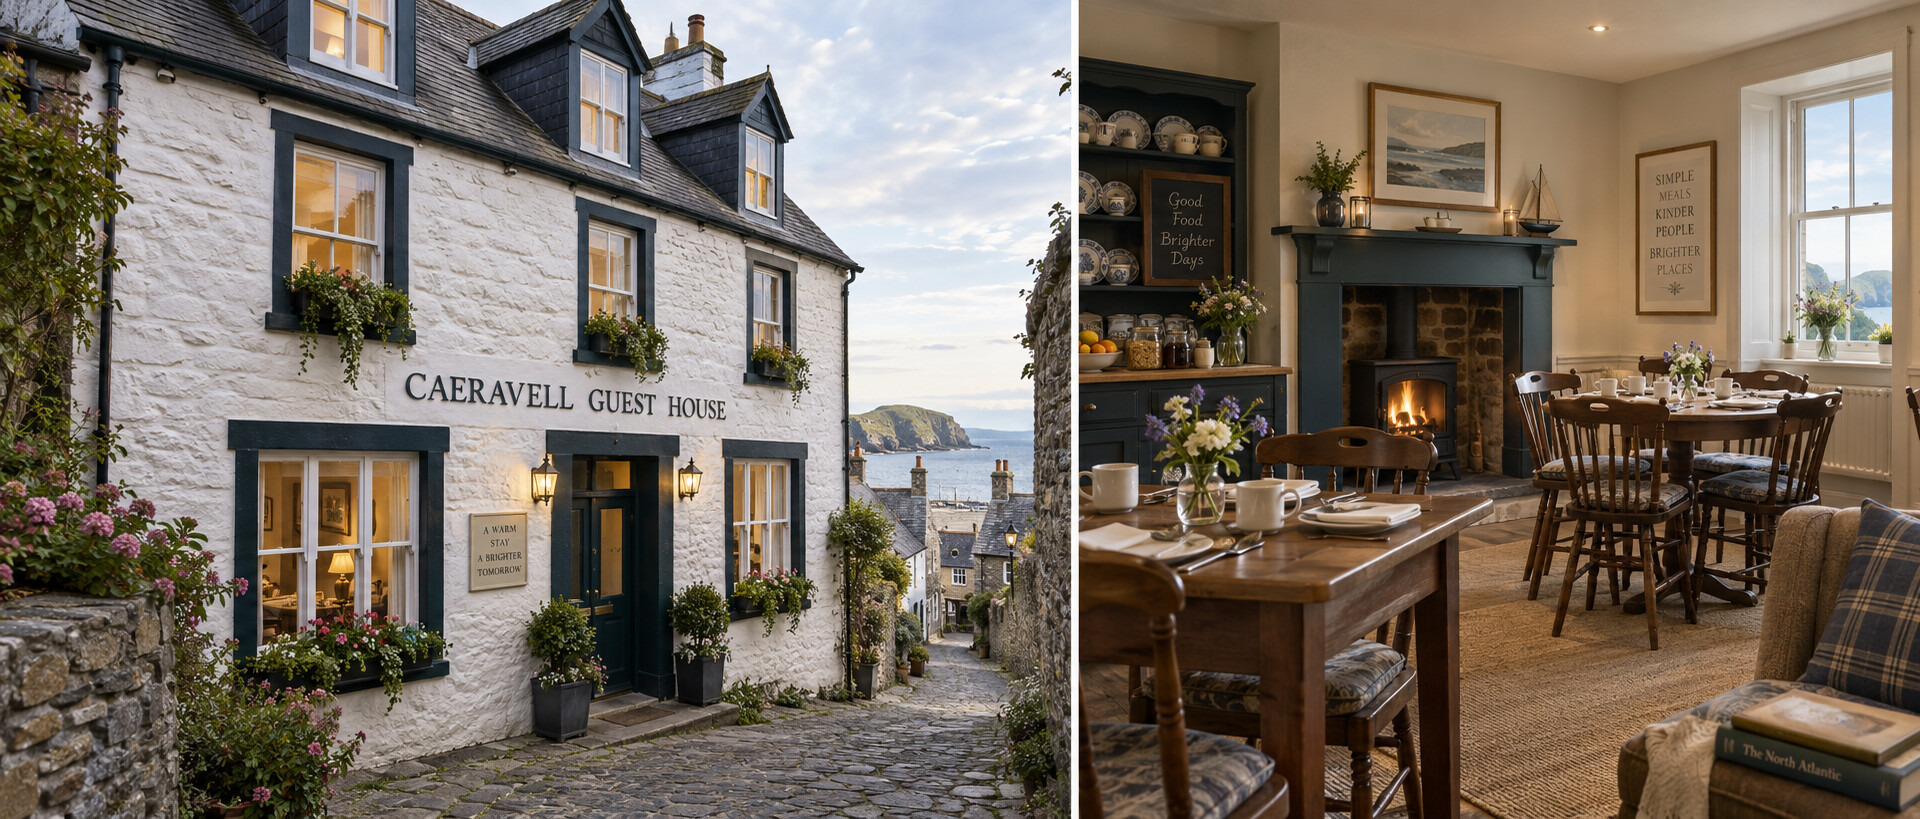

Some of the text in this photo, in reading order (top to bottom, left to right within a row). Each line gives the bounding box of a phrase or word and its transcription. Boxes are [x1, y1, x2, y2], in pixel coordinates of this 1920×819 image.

[1655, 169, 1695, 186] SIMPLE
[1168, 192, 1204, 210] Good
[1659, 188, 1691, 202] MEALS
[1173, 211, 1204, 226] Food
[1655, 205, 1694, 220] KINDER
[1655, 223, 1694, 238] PEOPLE
[1160, 231, 1215, 252] Brighter
[1650, 245, 1701, 259] BRIGHTER
[1170, 251, 1204, 271] Days
[1657, 263, 1693, 276] PLACES
[405, 372, 727, 420] CAERAVELL GUEST HOUSE
[483, 524, 517, 535] A WARM
[490, 538, 510, 548] STAY
[477, 551, 522, 562] A BRIGHTER
[477, 565, 522, 576] TOMORROW
[1743, 743, 1842, 782] The North Atlantic
